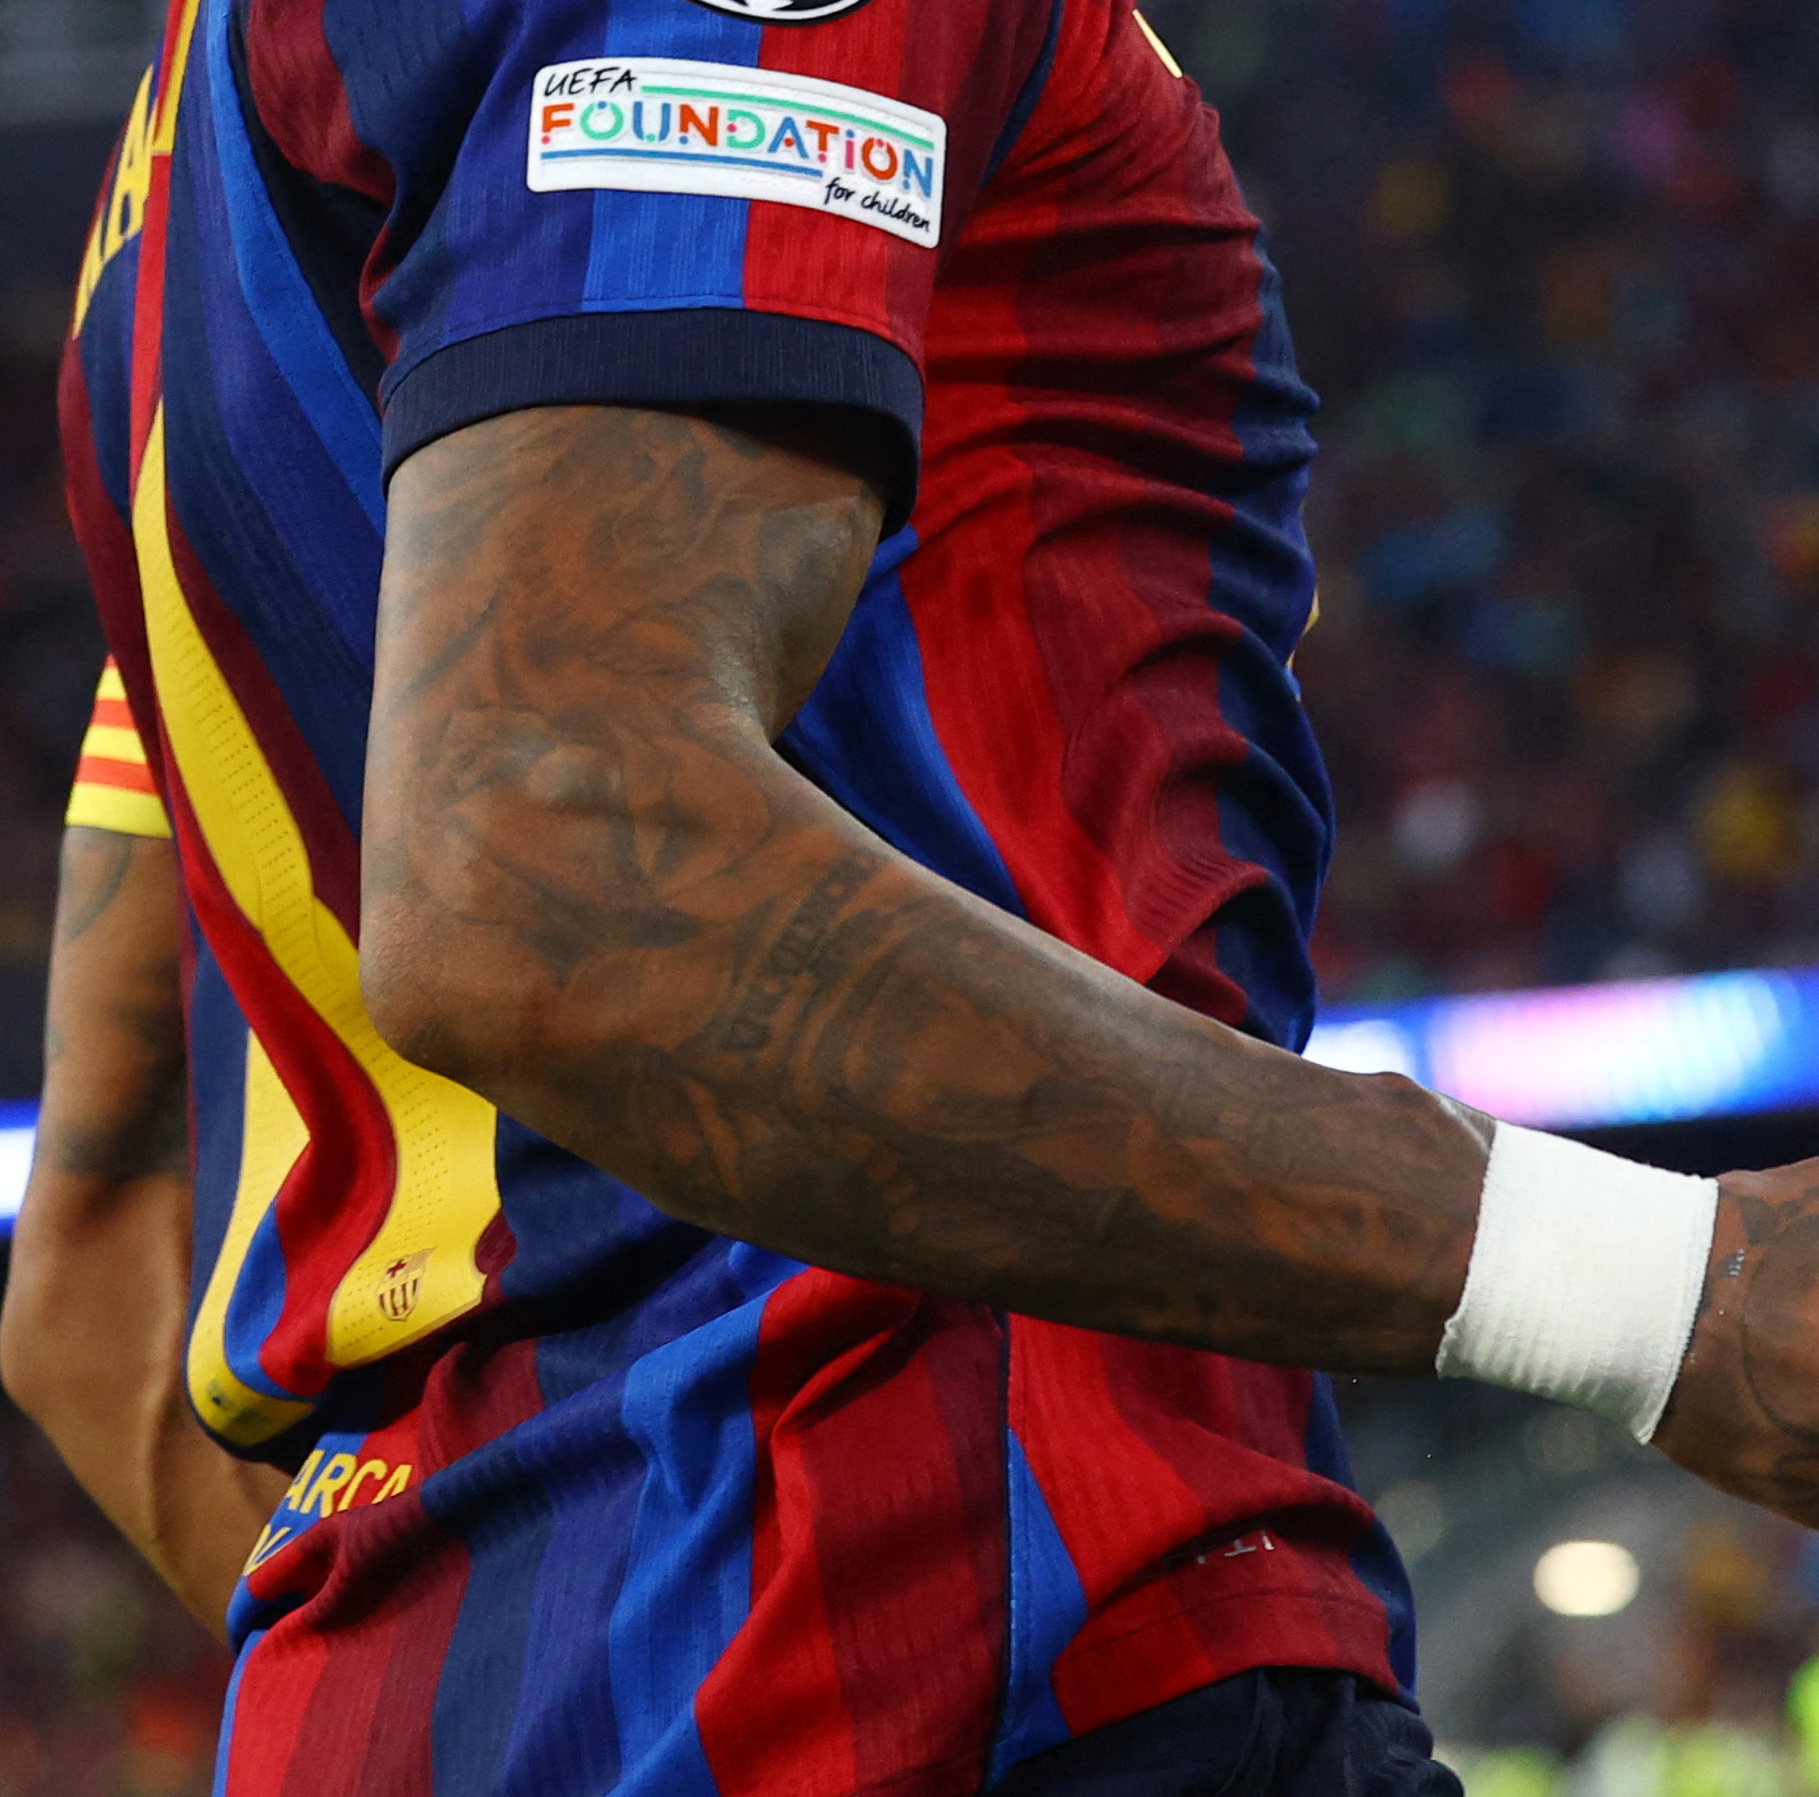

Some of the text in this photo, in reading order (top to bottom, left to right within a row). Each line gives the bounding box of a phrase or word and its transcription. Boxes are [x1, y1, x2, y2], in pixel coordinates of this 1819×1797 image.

[544, 66, 638, 97] UEFA
[541, 99, 934, 199] FOUNDATION
[823, 176, 931, 233] for children
